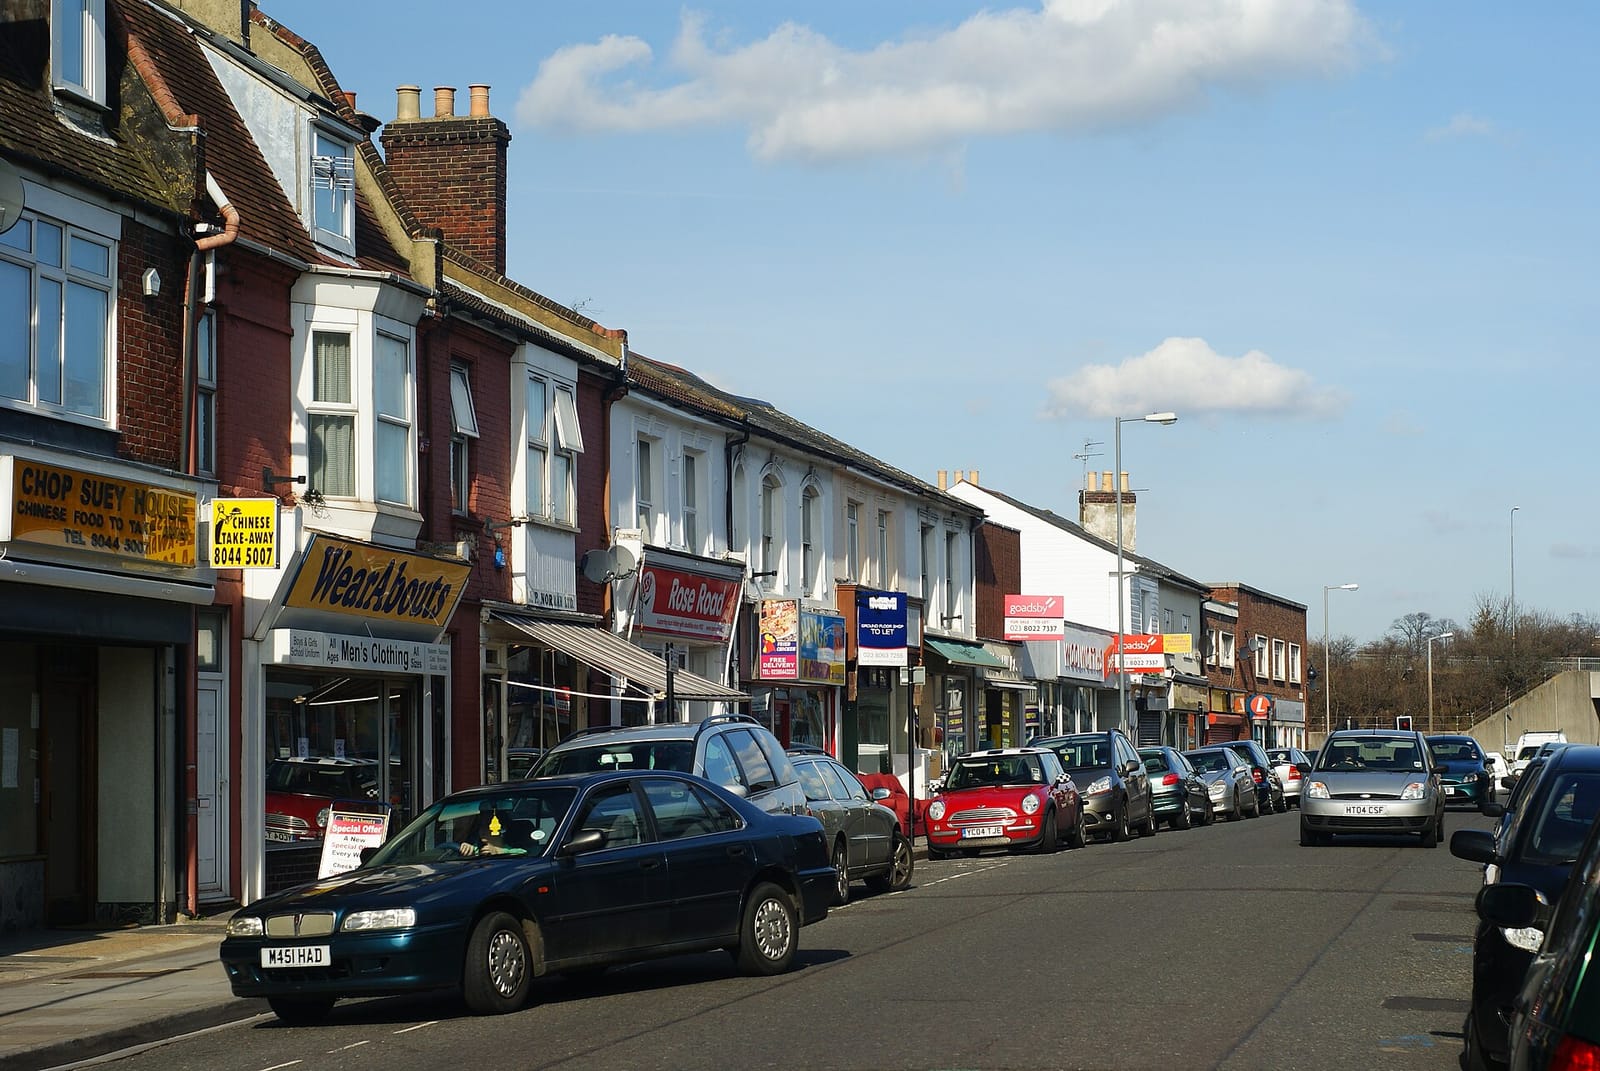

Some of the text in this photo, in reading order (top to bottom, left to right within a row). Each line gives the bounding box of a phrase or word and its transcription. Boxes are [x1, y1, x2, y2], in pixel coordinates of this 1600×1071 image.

[22, 467, 189, 521] CHOP SUEY HOUSE
[17, 501, 67, 522] CHINESE
[74, 510, 104, 528] FOOD
[110, 516, 124, 530] TO
[232, 516, 271, 529] CHINESE
[64, 528, 86, 546] TEL
[91, 533, 120, 550] 8044
[222, 531, 274, 545] TAKE-AWAY
[214, 547, 273, 565] 8044 5007
[310, 546, 453, 620] WearAbouts
[668, 578, 727, 617] Rose Road
[1009, 602, 1048, 615] goadsby
[327, 651, 340, 665] Ages
[329, 638, 337, 648] All
[341, 639, 368, 663] Men's
[371, 643, 409, 671] Clothing
[1345, 806, 1384, 815] HT04 CSF
[331, 824, 382, 834] Special Offer
[966, 828, 986, 836] YC04
[331, 850, 352, 858] Every
[269, 947, 322, 964] M451 HAD
